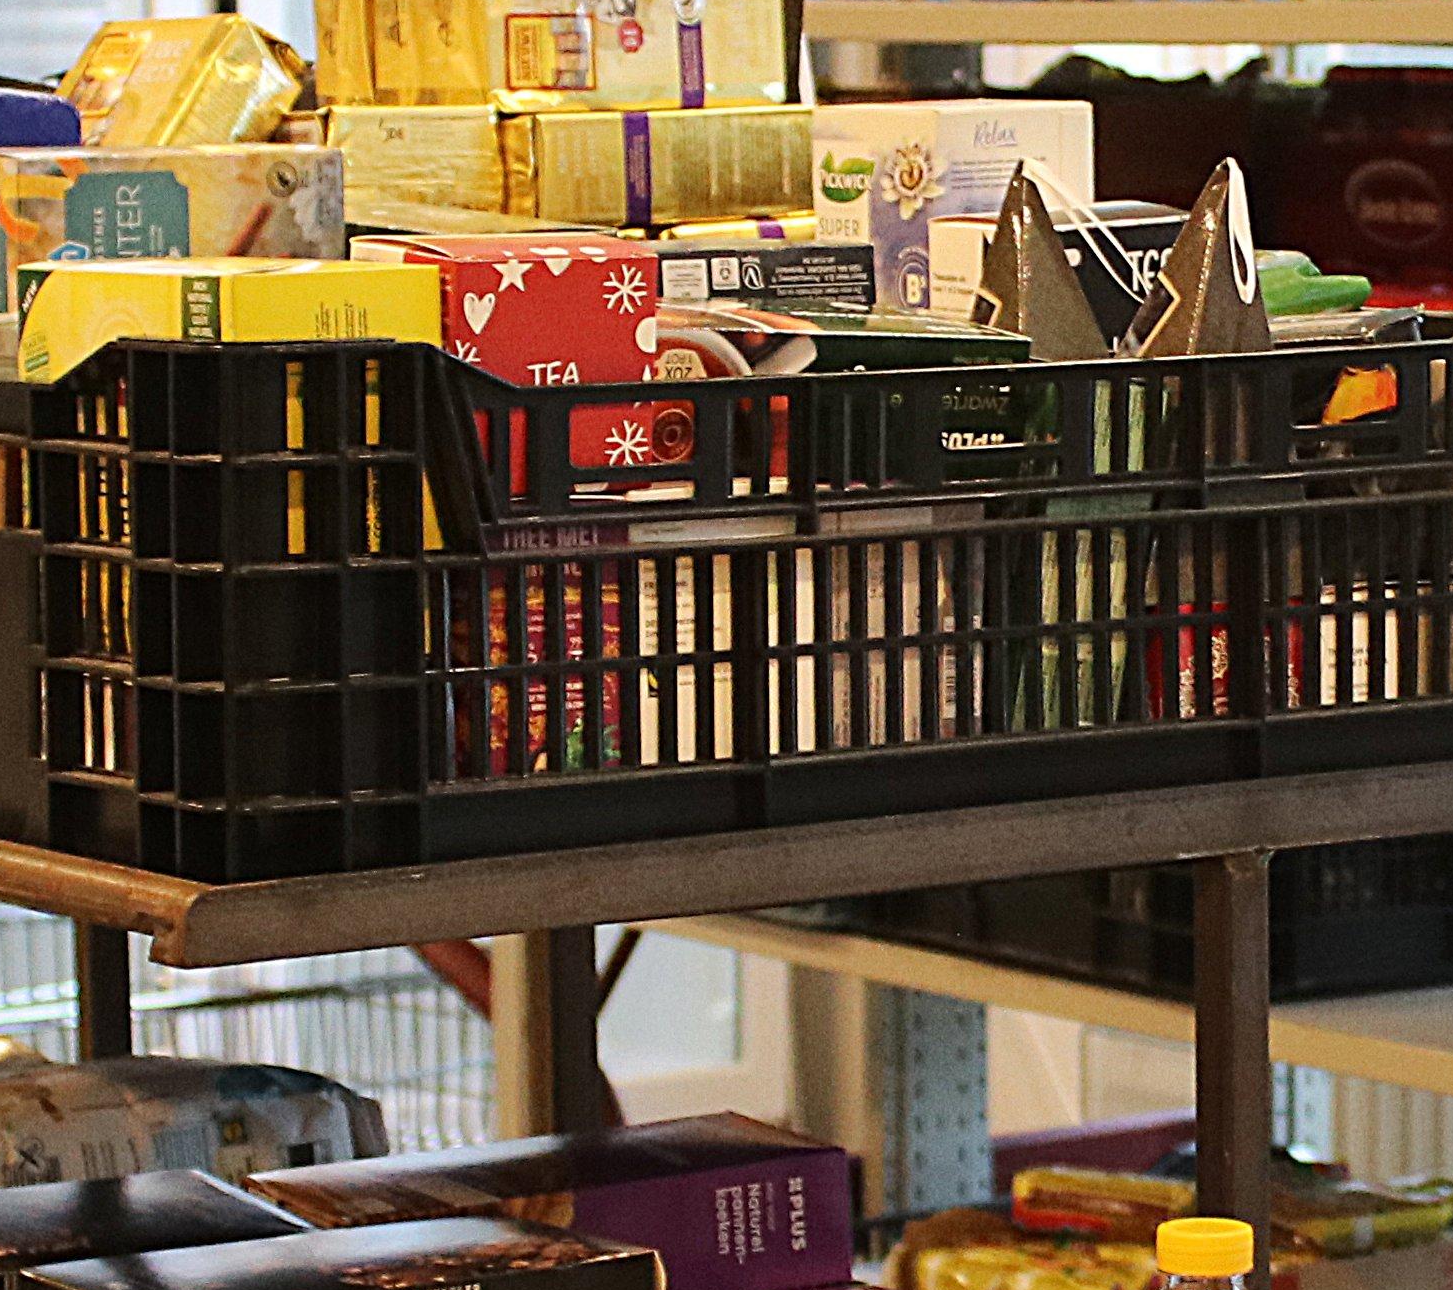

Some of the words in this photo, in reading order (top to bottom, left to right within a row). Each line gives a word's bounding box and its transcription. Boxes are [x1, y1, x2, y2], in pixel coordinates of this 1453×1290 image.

[819, 170, 874, 192] PICKWICK
[817, 217, 860, 237] SUPER
[526, 361, 580, 387] TEA
[715, 1189, 731, 1257] koeken
[731, 1186, 747, 1266] pannen-
[747, 1183, 764, 1255] Naturel
[790, 1196, 807, 1253] PLUS
